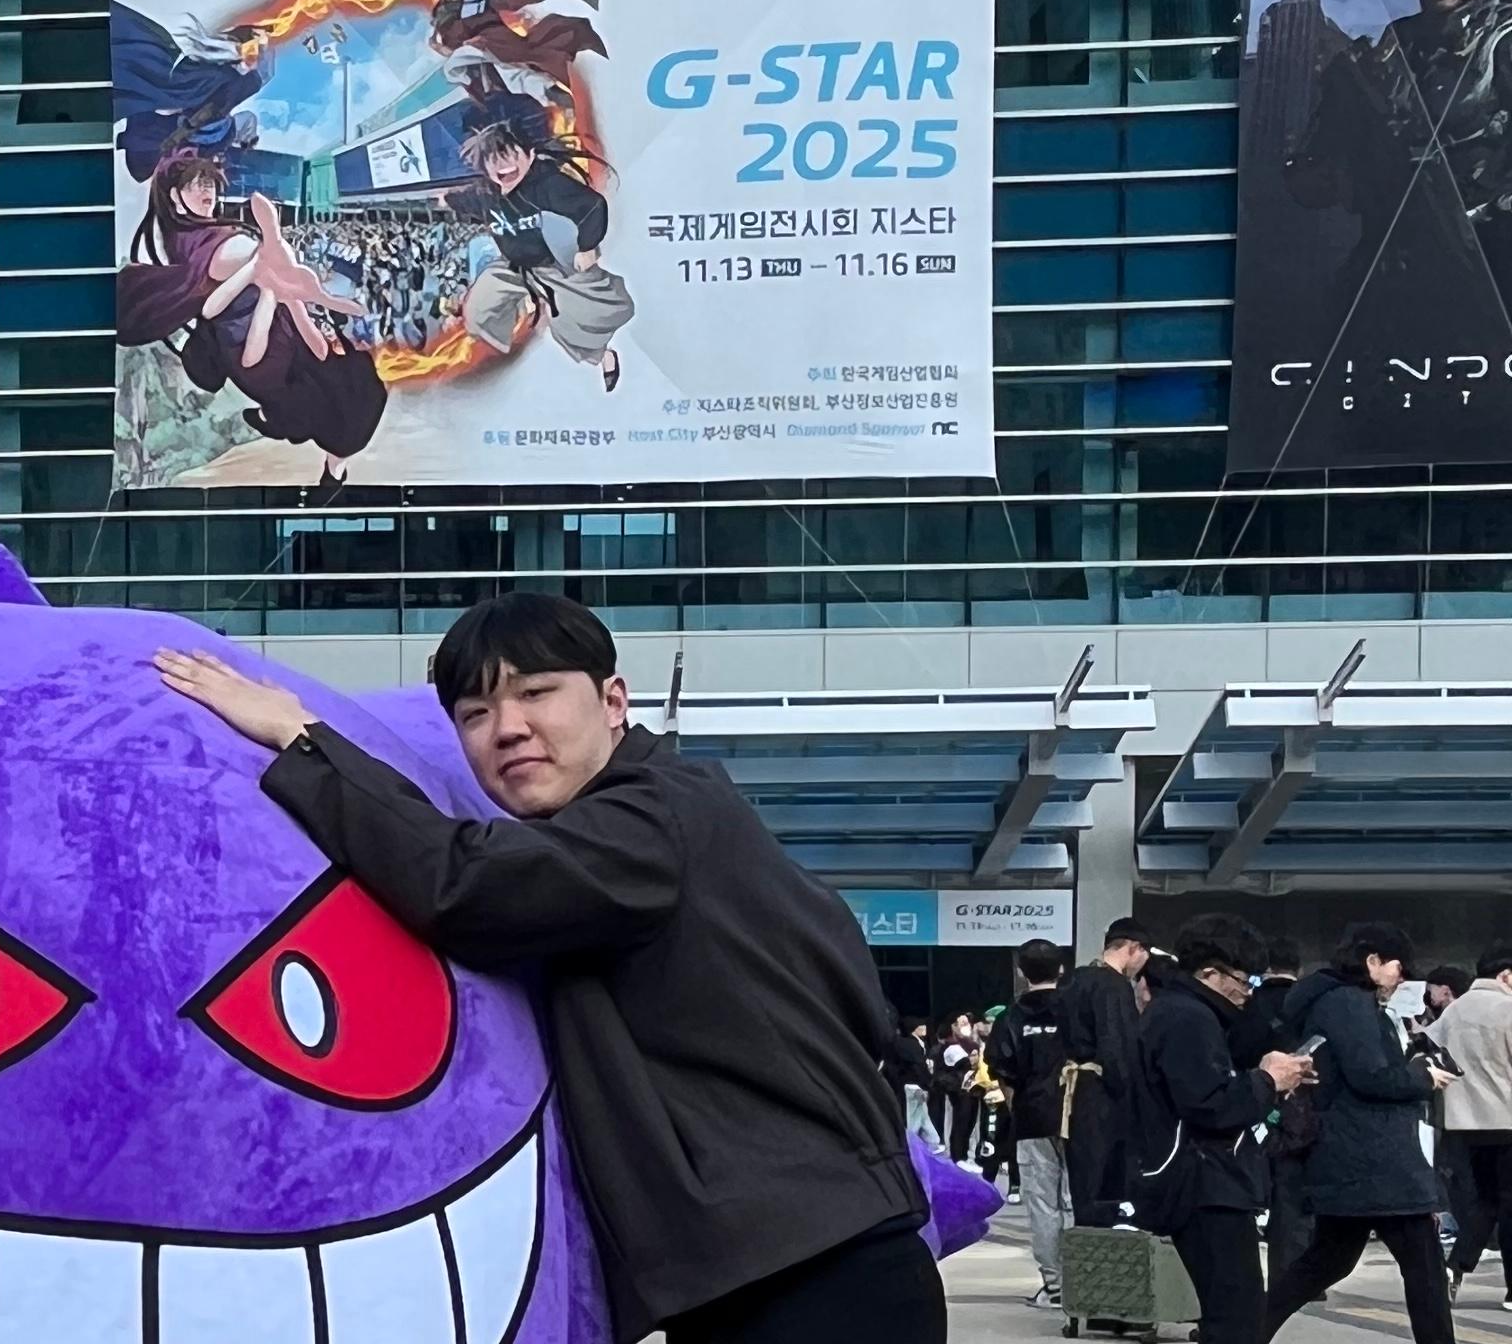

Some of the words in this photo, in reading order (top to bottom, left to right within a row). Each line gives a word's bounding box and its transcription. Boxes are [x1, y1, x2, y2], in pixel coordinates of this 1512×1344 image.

[646, 40, 960, 109] G-STAR
[736, 118, 959, 183] 2025
[648, 207, 859, 242] 국제게임전시회
[870, 206, 957, 235] 지스타
[677, 256, 752, 283] 11.13
[834, 252, 909, 277] 11.16
[931, 421, 959, 435] nc
